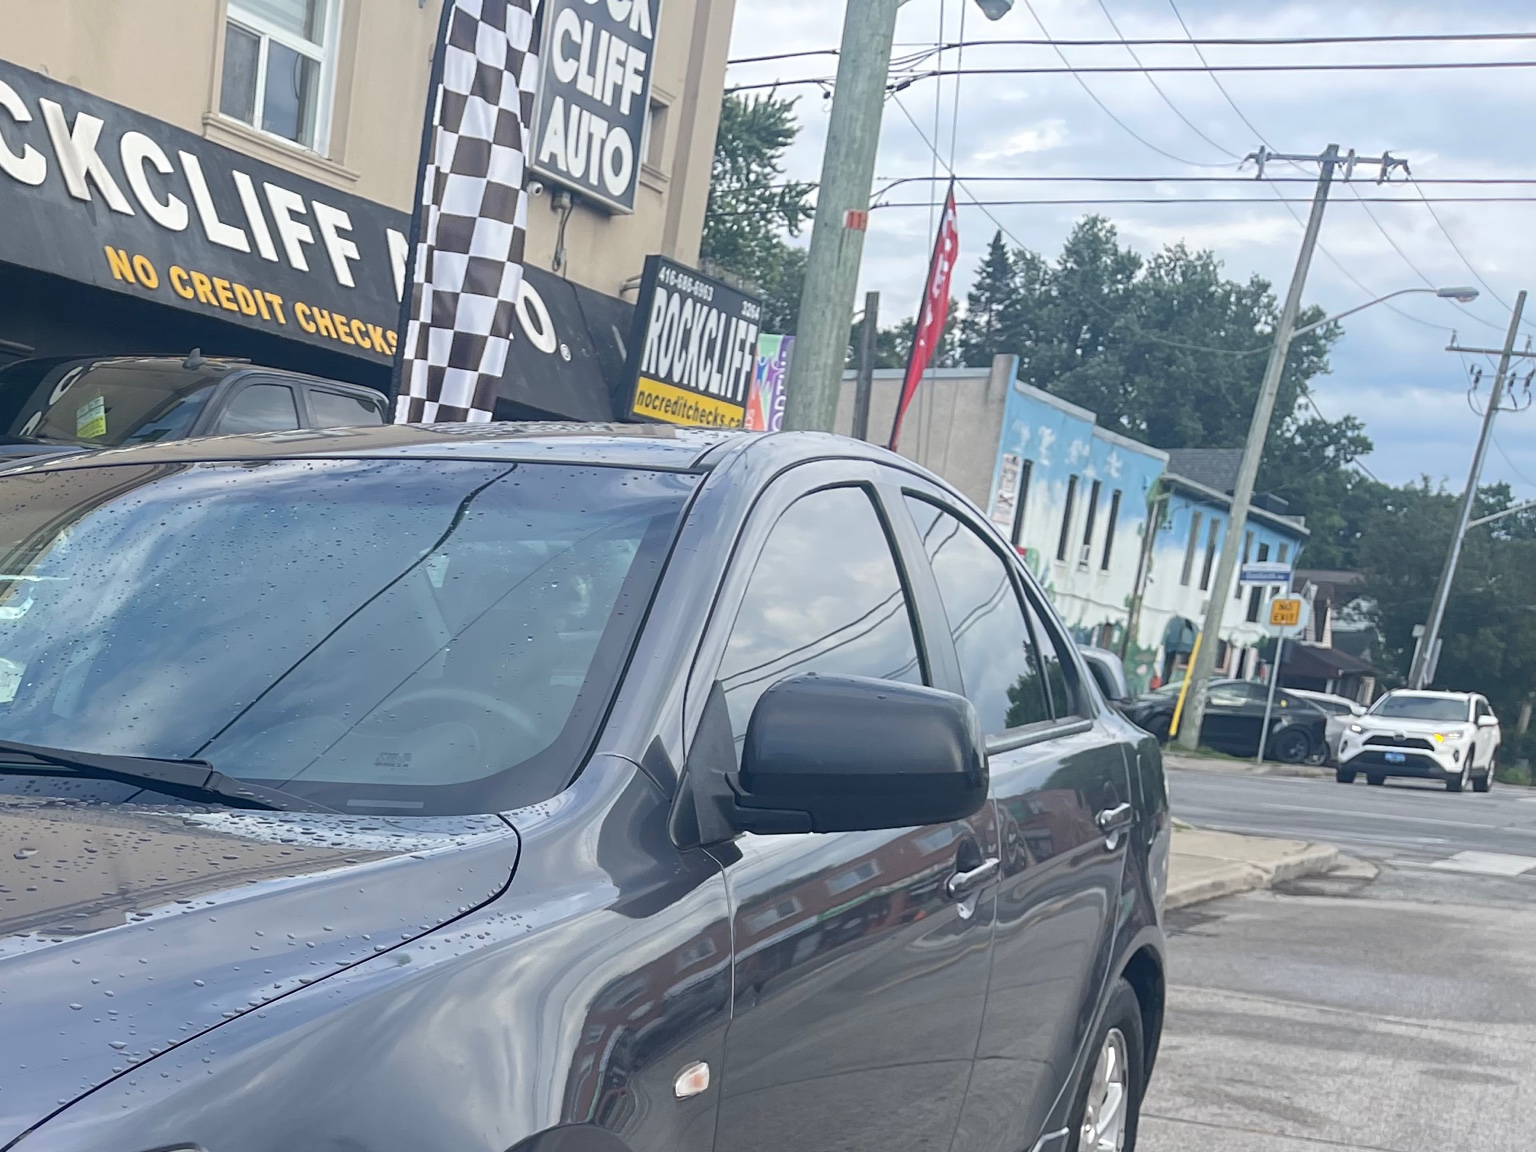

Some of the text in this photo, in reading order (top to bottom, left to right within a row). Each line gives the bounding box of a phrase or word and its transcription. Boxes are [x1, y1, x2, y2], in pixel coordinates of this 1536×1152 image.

[552, 7, 647, 116] CLIFF
[539, 95, 633, 196] AUTO
[104, 245, 159, 289] NO
[169, 265, 286, 324] CREDIT
[640, 286, 759, 402] ROCKCLIFF
[1273, 613, 1294, 621] EXIT
[1279, 603, 1293, 611] NO
